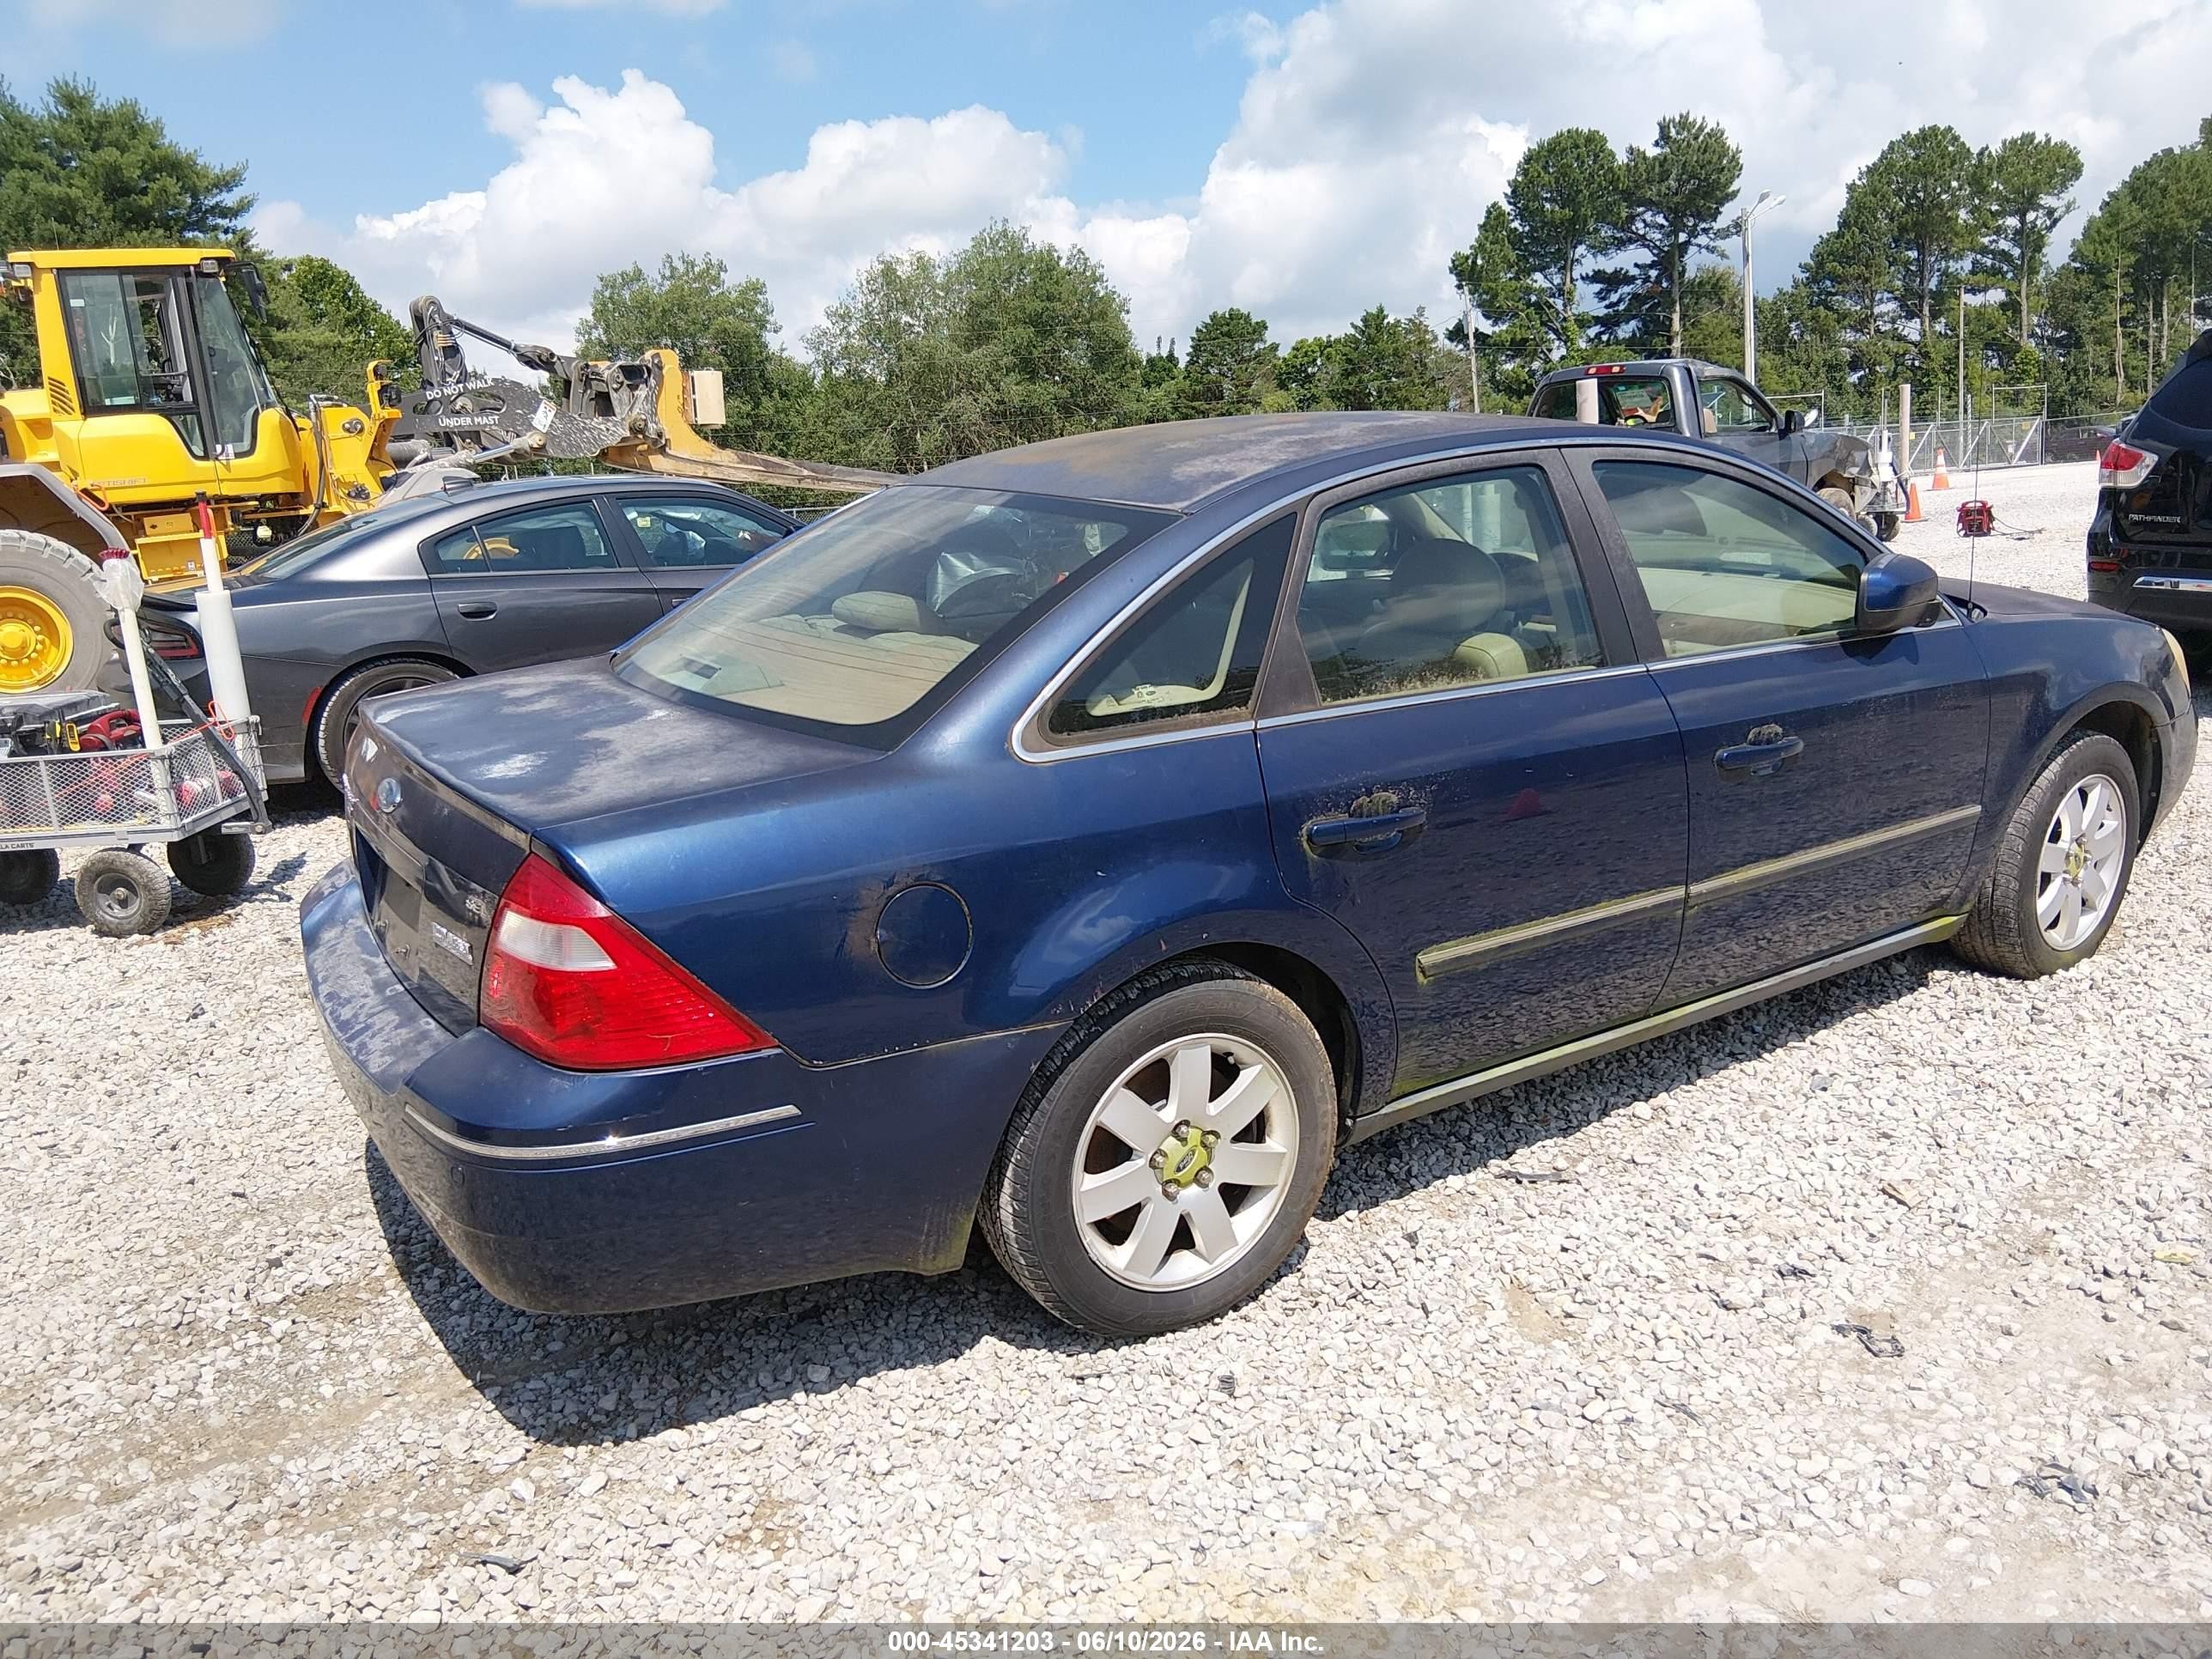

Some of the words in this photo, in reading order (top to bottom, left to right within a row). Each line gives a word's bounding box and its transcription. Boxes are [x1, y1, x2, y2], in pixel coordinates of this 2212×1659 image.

[426, 389, 441, 400] DO
[444, 385, 465, 395] NOT
[466, 379, 495, 391] WALK
[439, 416, 472, 427] UNDER
[475, 416, 500, 425] MAST
[2129, 514, 2181, 523] PATHFINDER
